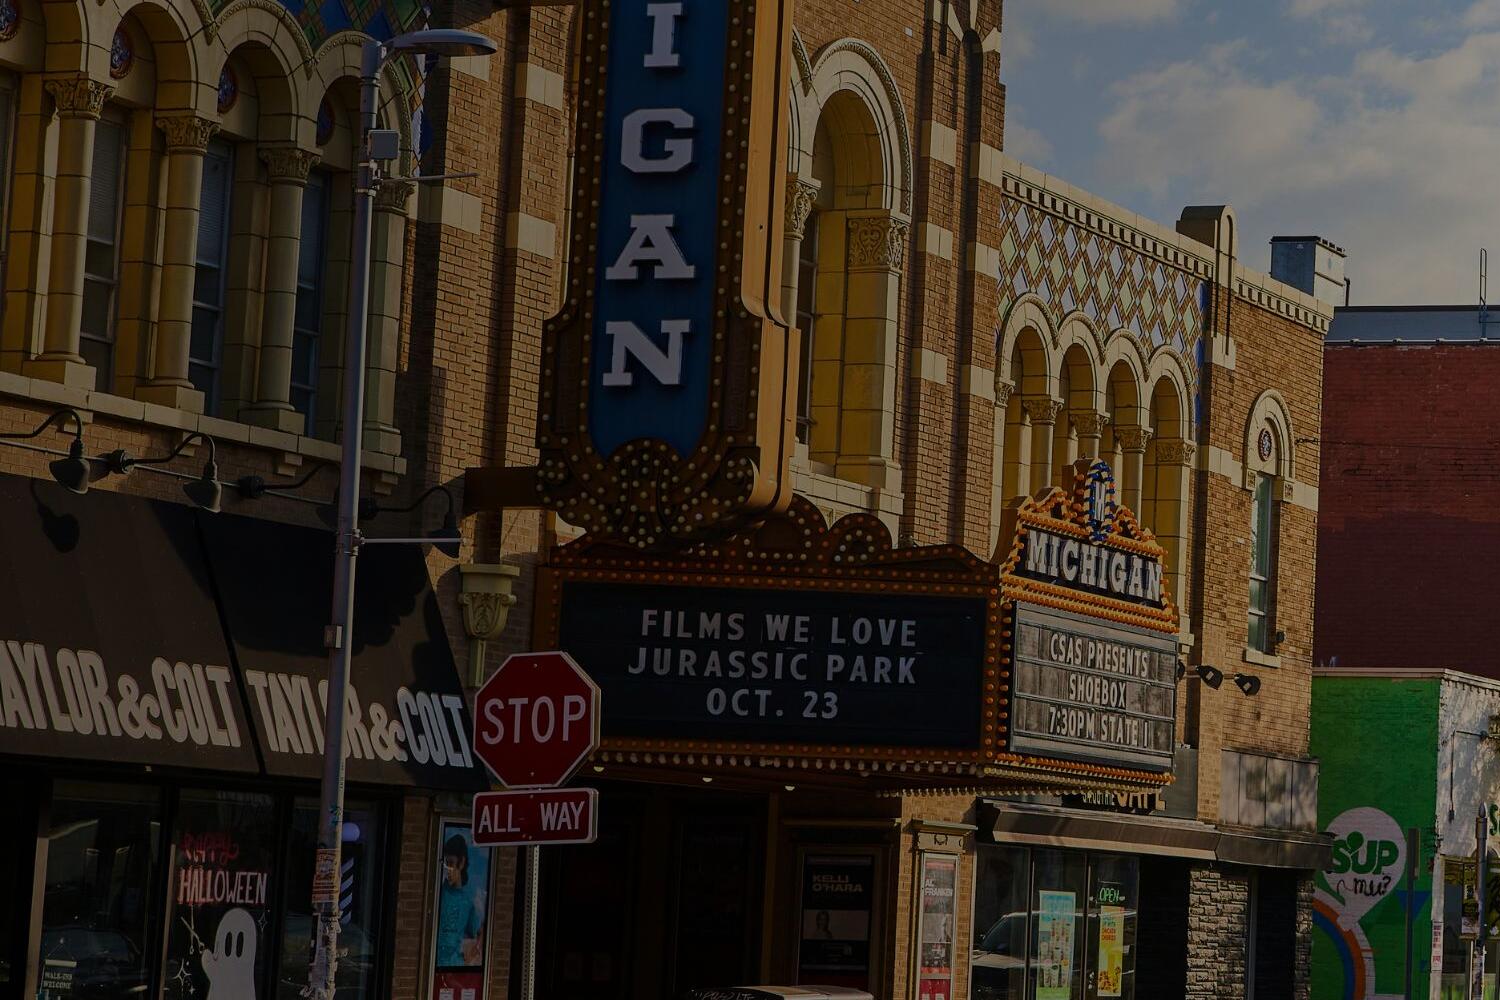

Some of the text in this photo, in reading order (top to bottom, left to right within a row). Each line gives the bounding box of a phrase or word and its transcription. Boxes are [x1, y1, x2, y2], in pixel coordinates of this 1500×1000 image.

[1027, 530, 1164, 603] MICHIGAN
[641, 608, 918, 648] FILMS WE LOVE
[627, 646, 917, 686] JURASSIC PARK
[1050, 633, 1149, 678] CSAS PRESENTS
[705, 689, 840, 720] OCT. 23
[1069, 674, 1126, 709] SHOEBOX
[482, 694, 587, 745] STOP
[1049, 706, 1096, 739] 7:30PM
[1101, 714, 1138, 747] STATE
[478, 800, 585, 834] ALL WAY
[178, 867, 268, 905] HALLOWEEN
[812, 874, 849, 883] KELLI
[925, 879, 934, 888] AL
[925, 888, 953, 897] FRANKEN
[1099, 887, 1120, 903] OPEN
